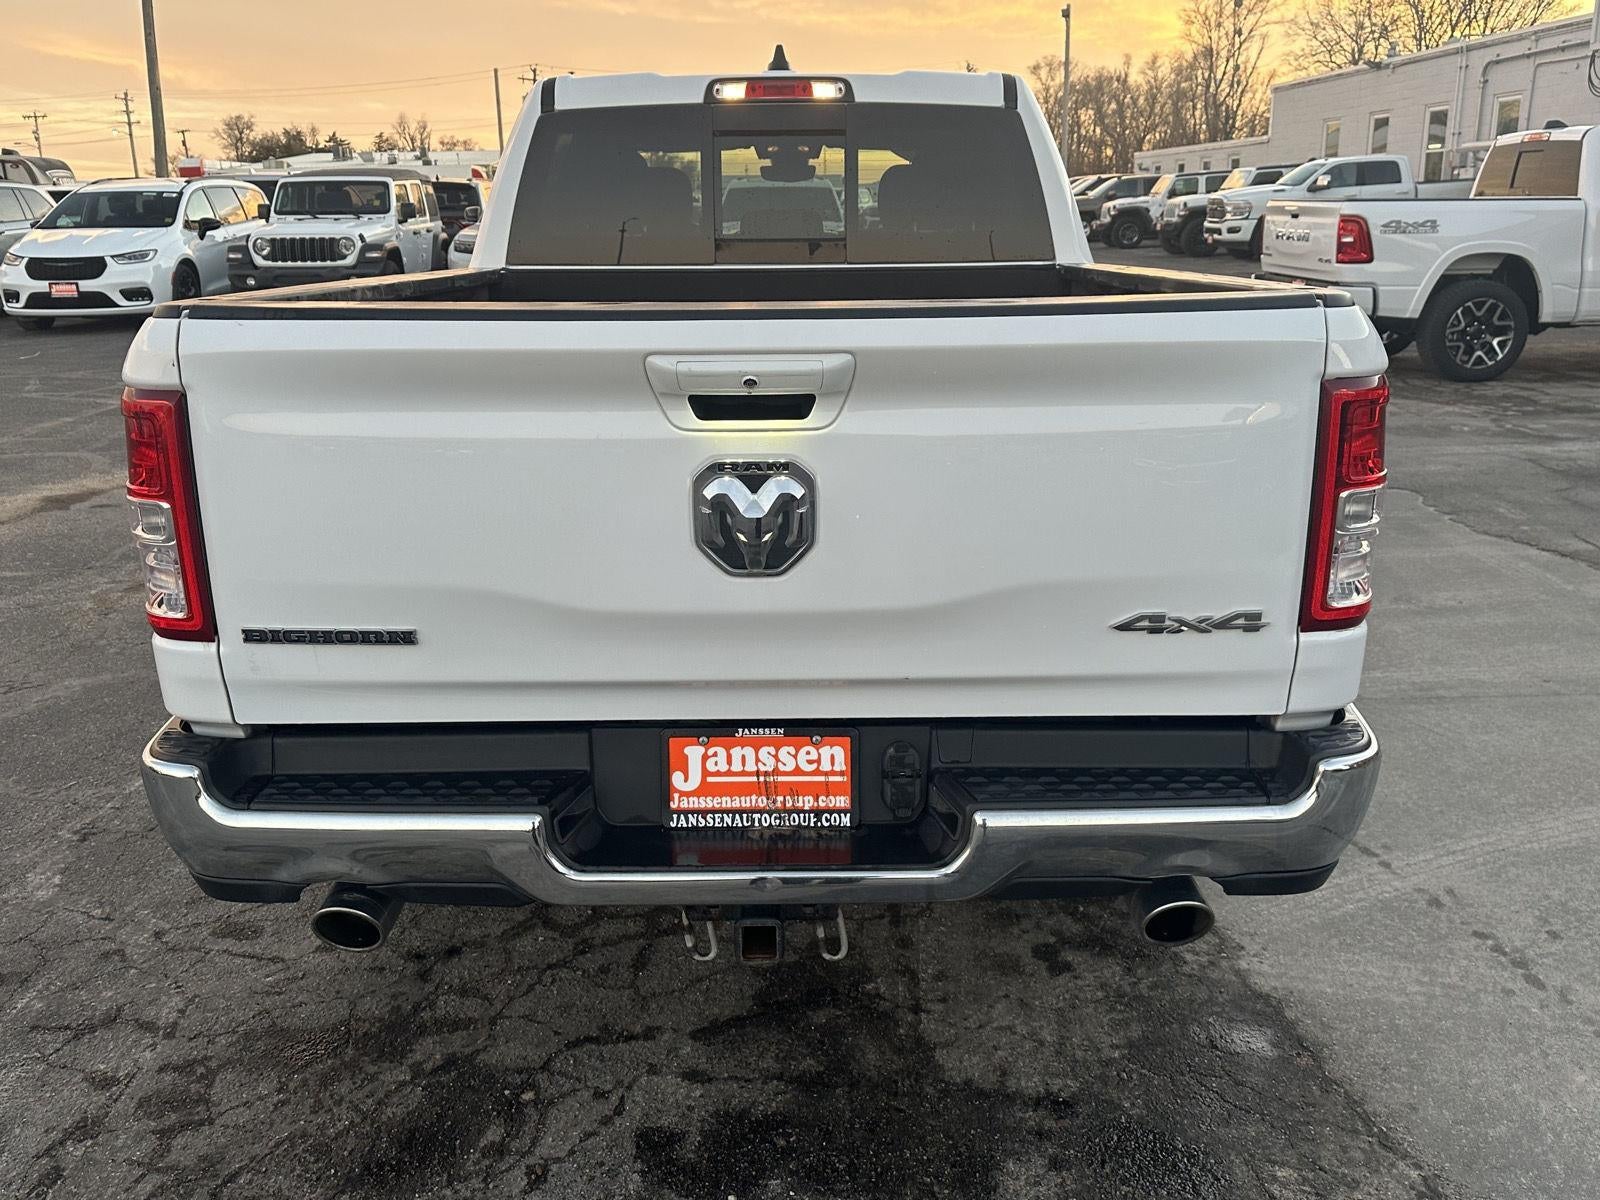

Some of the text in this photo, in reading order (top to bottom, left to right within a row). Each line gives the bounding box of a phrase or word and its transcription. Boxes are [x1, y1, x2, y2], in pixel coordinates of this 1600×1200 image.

[1380, 219, 1440, 230] 4x4
[1276, 228, 1310, 242] RAM
[717, 462, 790, 473] RAM
[1109, 610, 1270, 634] 4x4
[241, 627, 418, 645] BIGHORN
[735, 727, 784, 737] JANSSEN
[672, 745, 846, 792] Janssen
